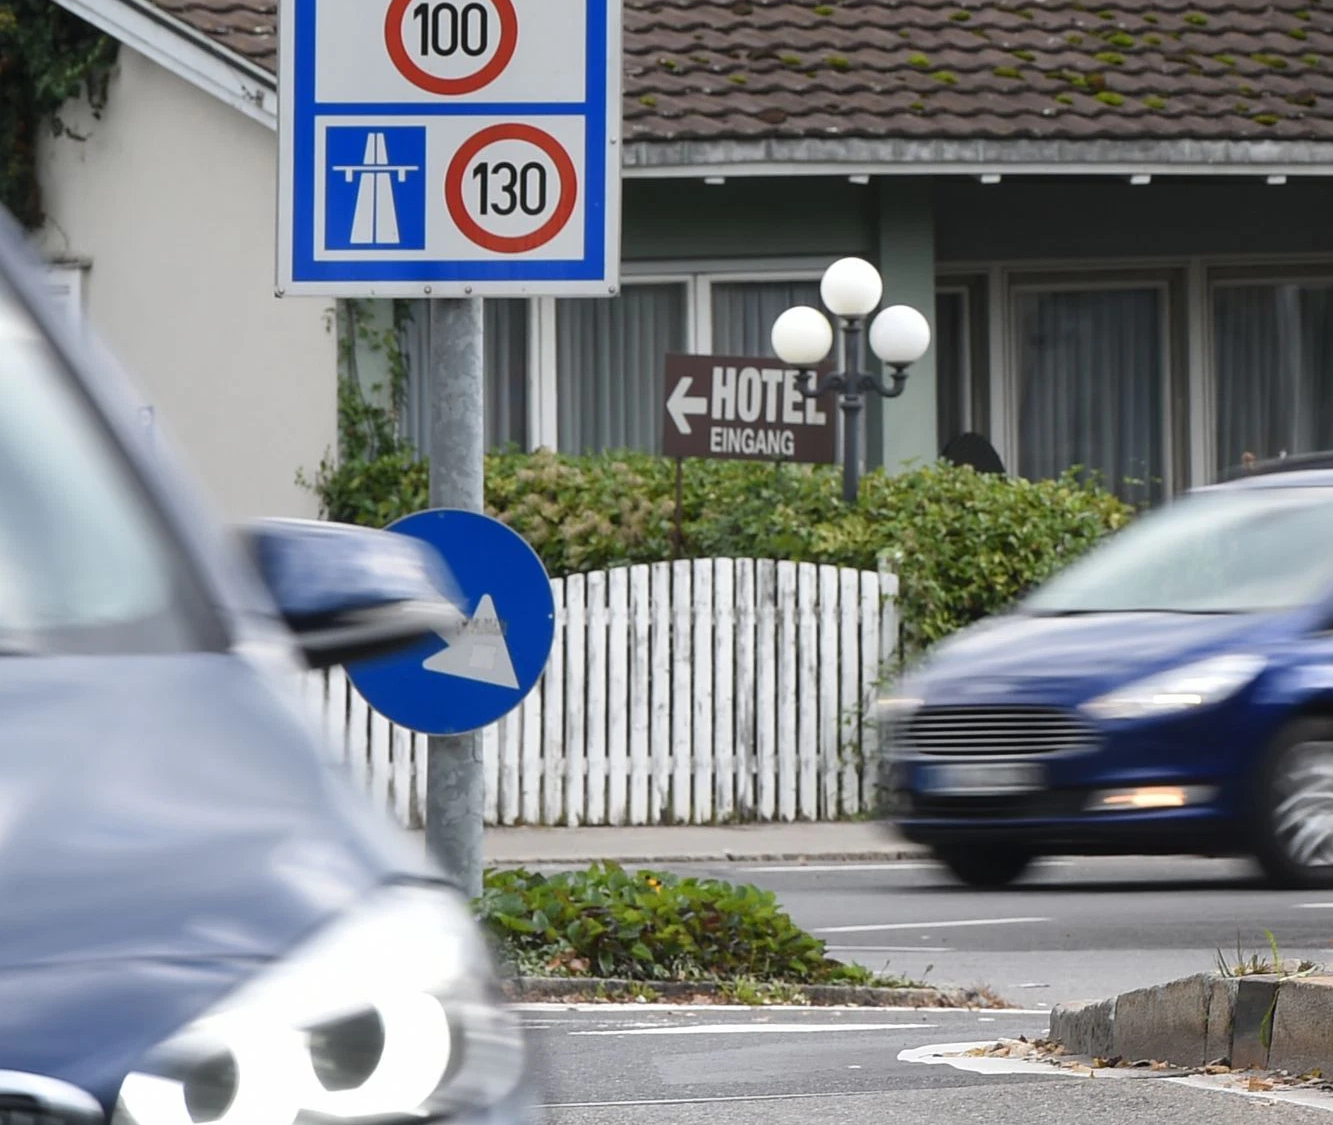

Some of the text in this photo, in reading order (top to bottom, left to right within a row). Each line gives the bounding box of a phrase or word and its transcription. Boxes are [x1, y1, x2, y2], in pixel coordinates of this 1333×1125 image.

[413, 2, 488, 57] 100
[472, 161, 547, 216] 130
[711, 366, 827, 426] HOTEL
[710, 426, 795, 456] EINGANG
